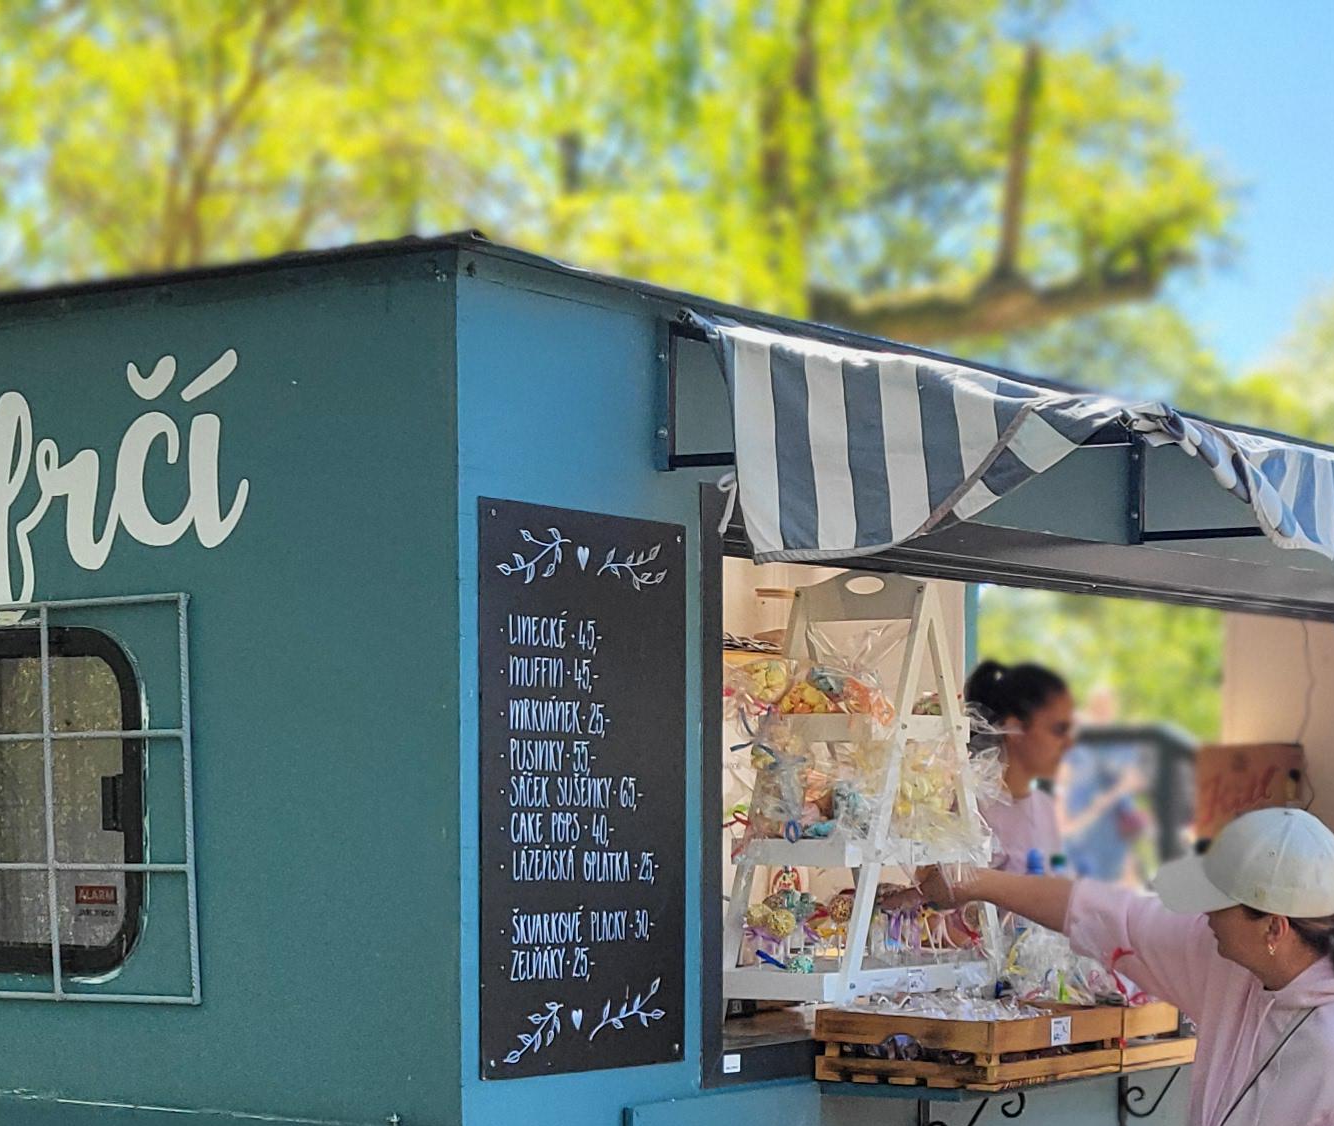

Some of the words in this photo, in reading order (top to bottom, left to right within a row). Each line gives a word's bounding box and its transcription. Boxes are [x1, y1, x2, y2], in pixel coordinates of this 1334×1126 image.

[508, 610, 568, 649] LINECKÉ
[508, 655, 564, 688] MUFFIN
[509, 695, 582, 734] MRKVÁNEK
[510, 738, 564, 771] PUSINKY
[509, 771, 550, 808] SÁČEK
[557, 772, 613, 809] SUŠENKY
[510, 812, 543, 844] CAKE
[551, 812, 581, 843] POPS
[513, 844, 576, 881] LÁZEŇSKÁ
[583, 850, 630, 882] OPLATKA
[77, 889, 115, 901] ALARM
[512, 905, 583, 945] ŠKVARKOVÉ
[591, 910, 627, 942] PLACKY
